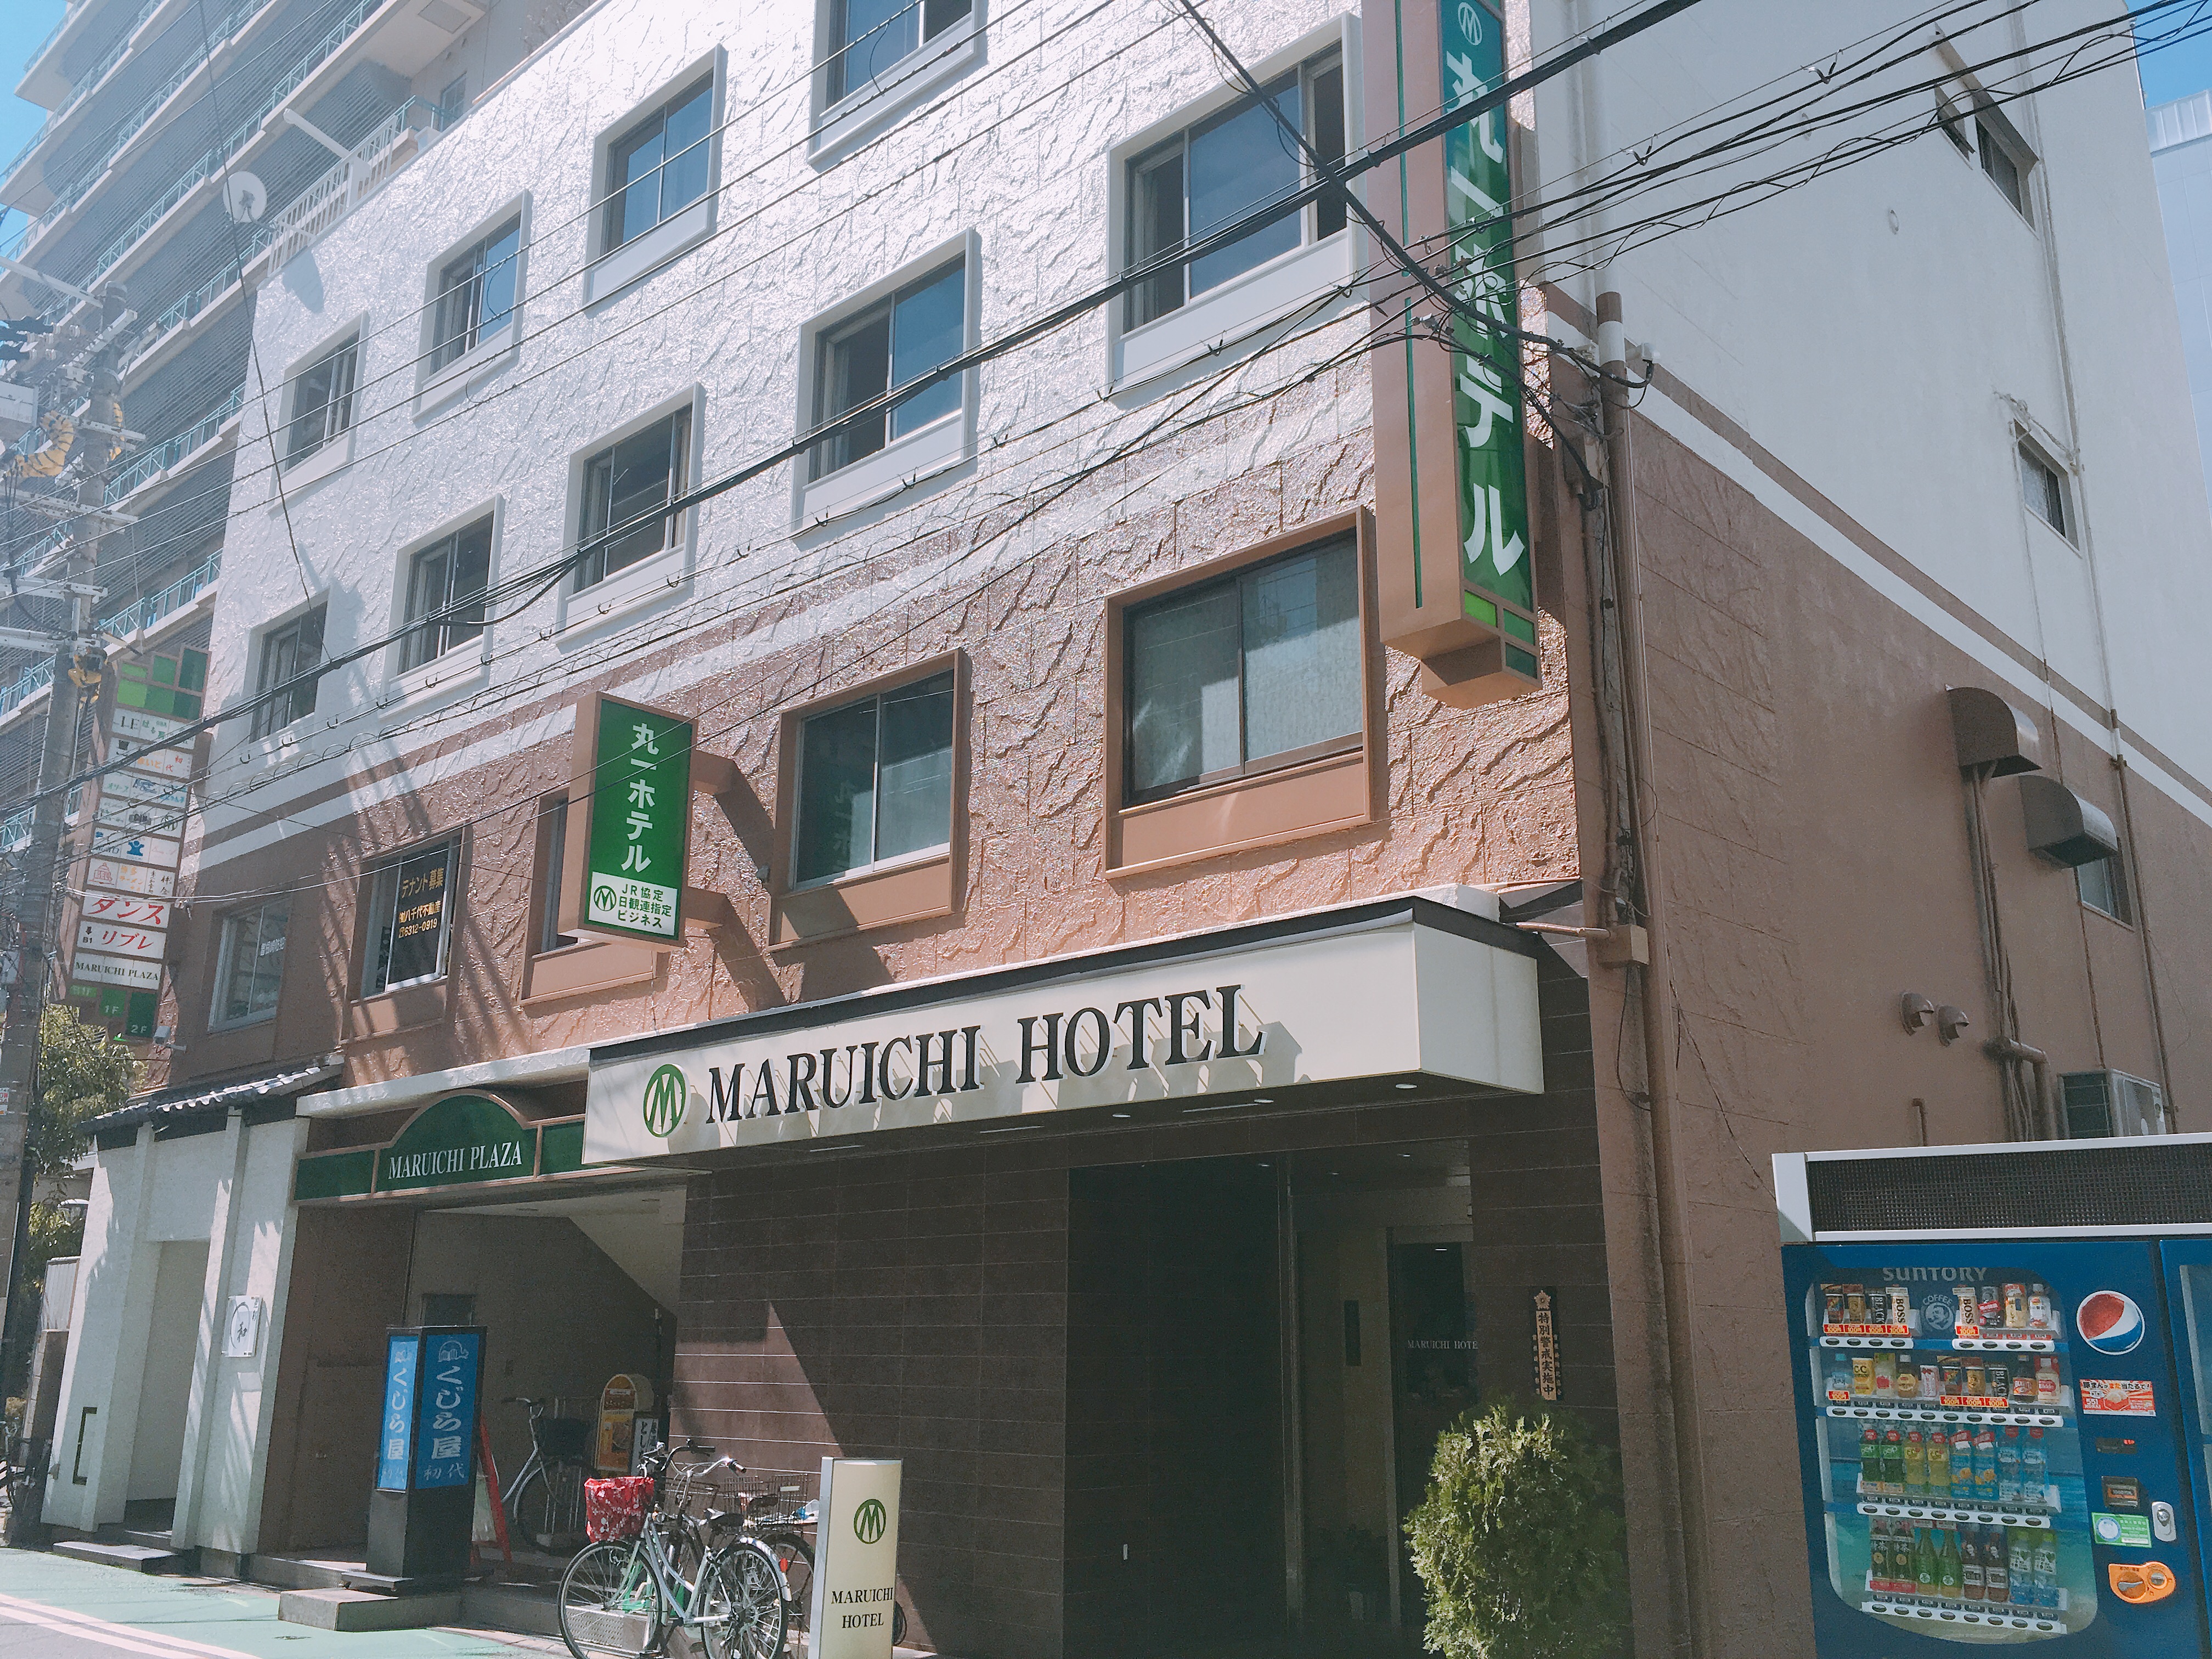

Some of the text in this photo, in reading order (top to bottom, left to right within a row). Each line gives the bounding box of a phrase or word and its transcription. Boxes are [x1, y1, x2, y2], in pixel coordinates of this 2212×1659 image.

[1446, 50, 1525, 575] 丸一ホテル
[622, 723, 659, 872] 丸一ホテル
[88, 898, 165, 924] ダンス
[619, 896, 672, 917] 日観連指定
[618, 910, 663, 929] ビジネス
[101, 931, 154, 950] リブレ
[75, 962, 159, 981] MARUICHI PLAZA
[105, 1005, 120, 1014] 1F
[131, 1024, 148, 1034] 2F
[706, 984, 1267, 1124] MARUICHI HOTEL
[388, 1141, 522, 1180] MARUICHI PLAZA
[1874, 1296, 1885, 1324] BLACK
[1895, 1298, 1906, 1323] BOSS
[1923, 1294, 1953, 1306] COFFEE
[1963, 1299, 1974, 1325] BOSS
[1408, 1340, 1479, 1350] MARUICHI HOTE
[1538, 1312, 1555, 1396] 特別警戒実施中
[387, 1368, 408, 1460] くじら屋
[431, 1365, 462, 1460] くじら屋
[831, 1587, 894, 1604] MARUICHI
[842, 1613, 884, 1629] HOTEL
